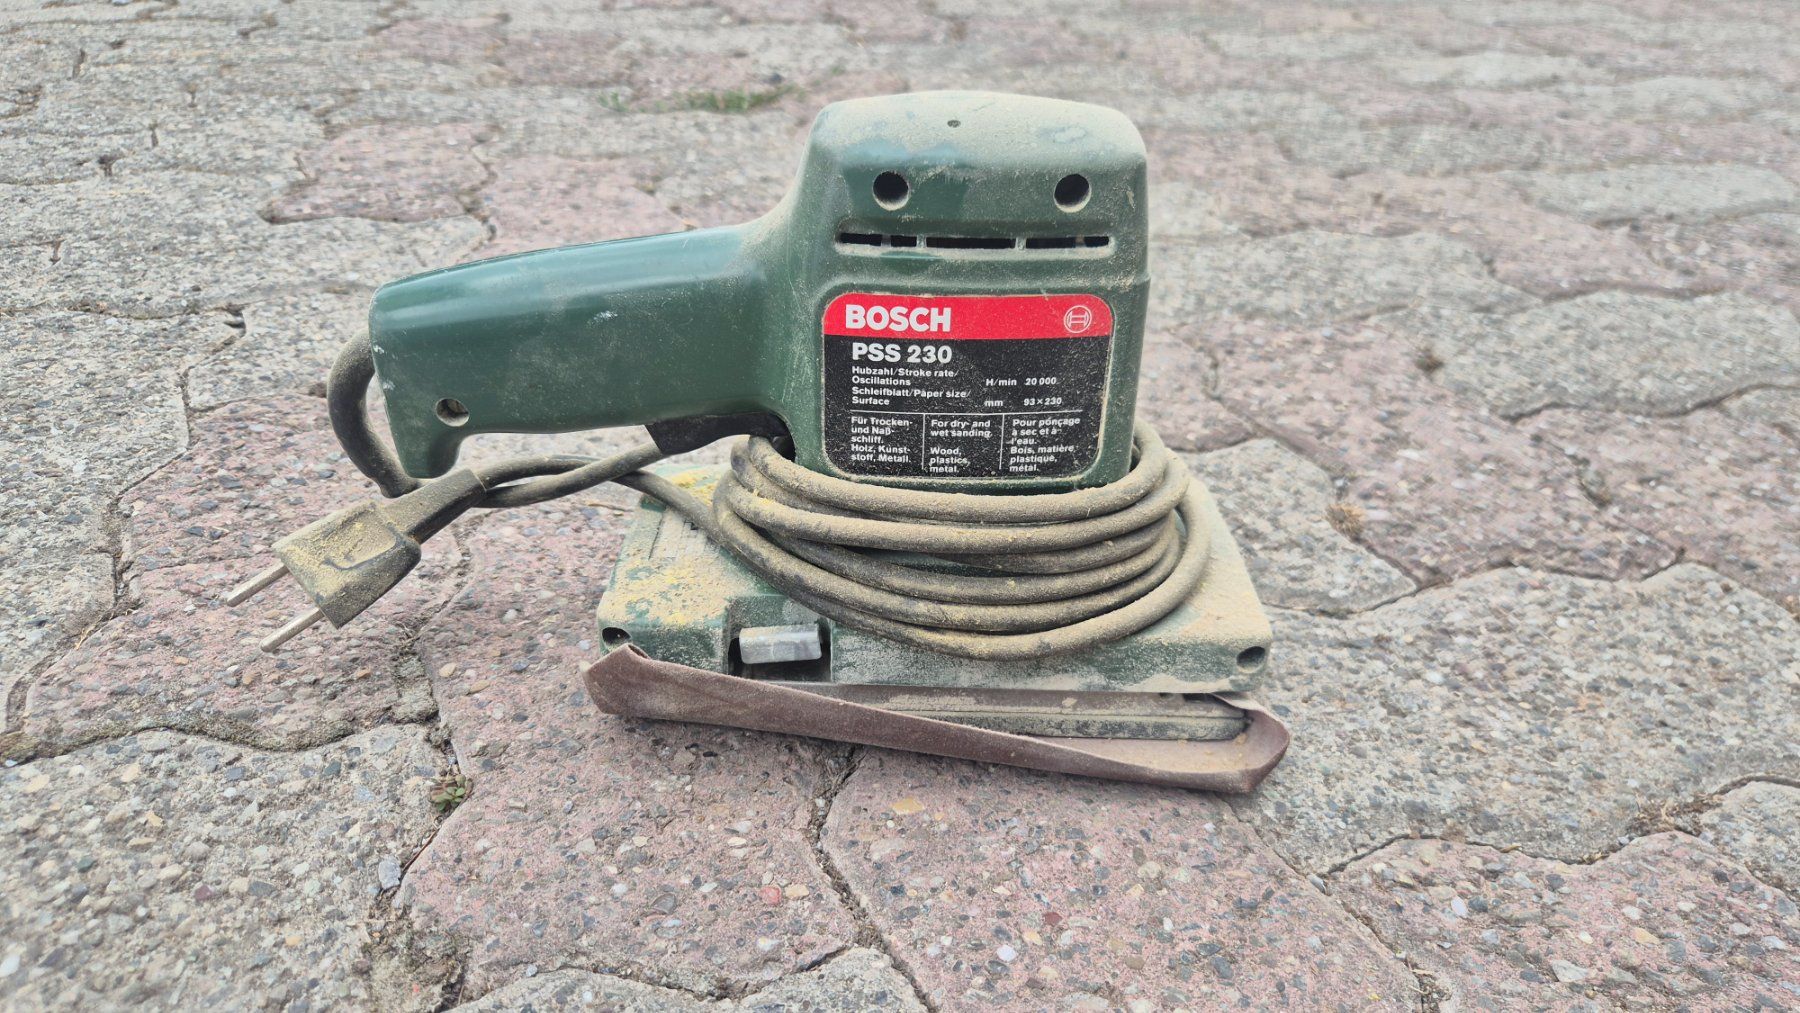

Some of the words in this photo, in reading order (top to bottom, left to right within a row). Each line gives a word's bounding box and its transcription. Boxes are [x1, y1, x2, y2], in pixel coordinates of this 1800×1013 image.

[846, 304, 951, 332] BOSCH
[852, 342, 901, 362] PSS
[906, 344, 952, 364] 230
[852, 366, 932, 377] Hubzahl/Stroke
[934, 369, 960, 378] rate/
[852, 376, 912, 386] Oscillations
[985, 378, 1017, 386] H/min
[852, 386, 944, 398] Schleifblatt/Paper
[946, 389, 972, 398] size/
[852, 396, 890, 406] Surface
[851, 416, 868, 424] Für
[870, 417, 913, 426] Trocken-
[1038, 418, 1080, 428] ponçage
[871, 426, 895, 436] Naß-
[851, 435, 884, 444] schliff.
[850, 444, 876, 454] Holz,
[878, 445, 911, 454] Kunst-
[930, 446, 962, 456] Wood,
[1010, 446, 1035, 454] Bois,
[851, 454, 876, 462] stoff,
[878, 454, 912, 463] Metall.
[929, 456, 970, 467] plastics,
[1010, 455, 1057, 465] plastique,
[1009, 464, 1040, 472] métal.
